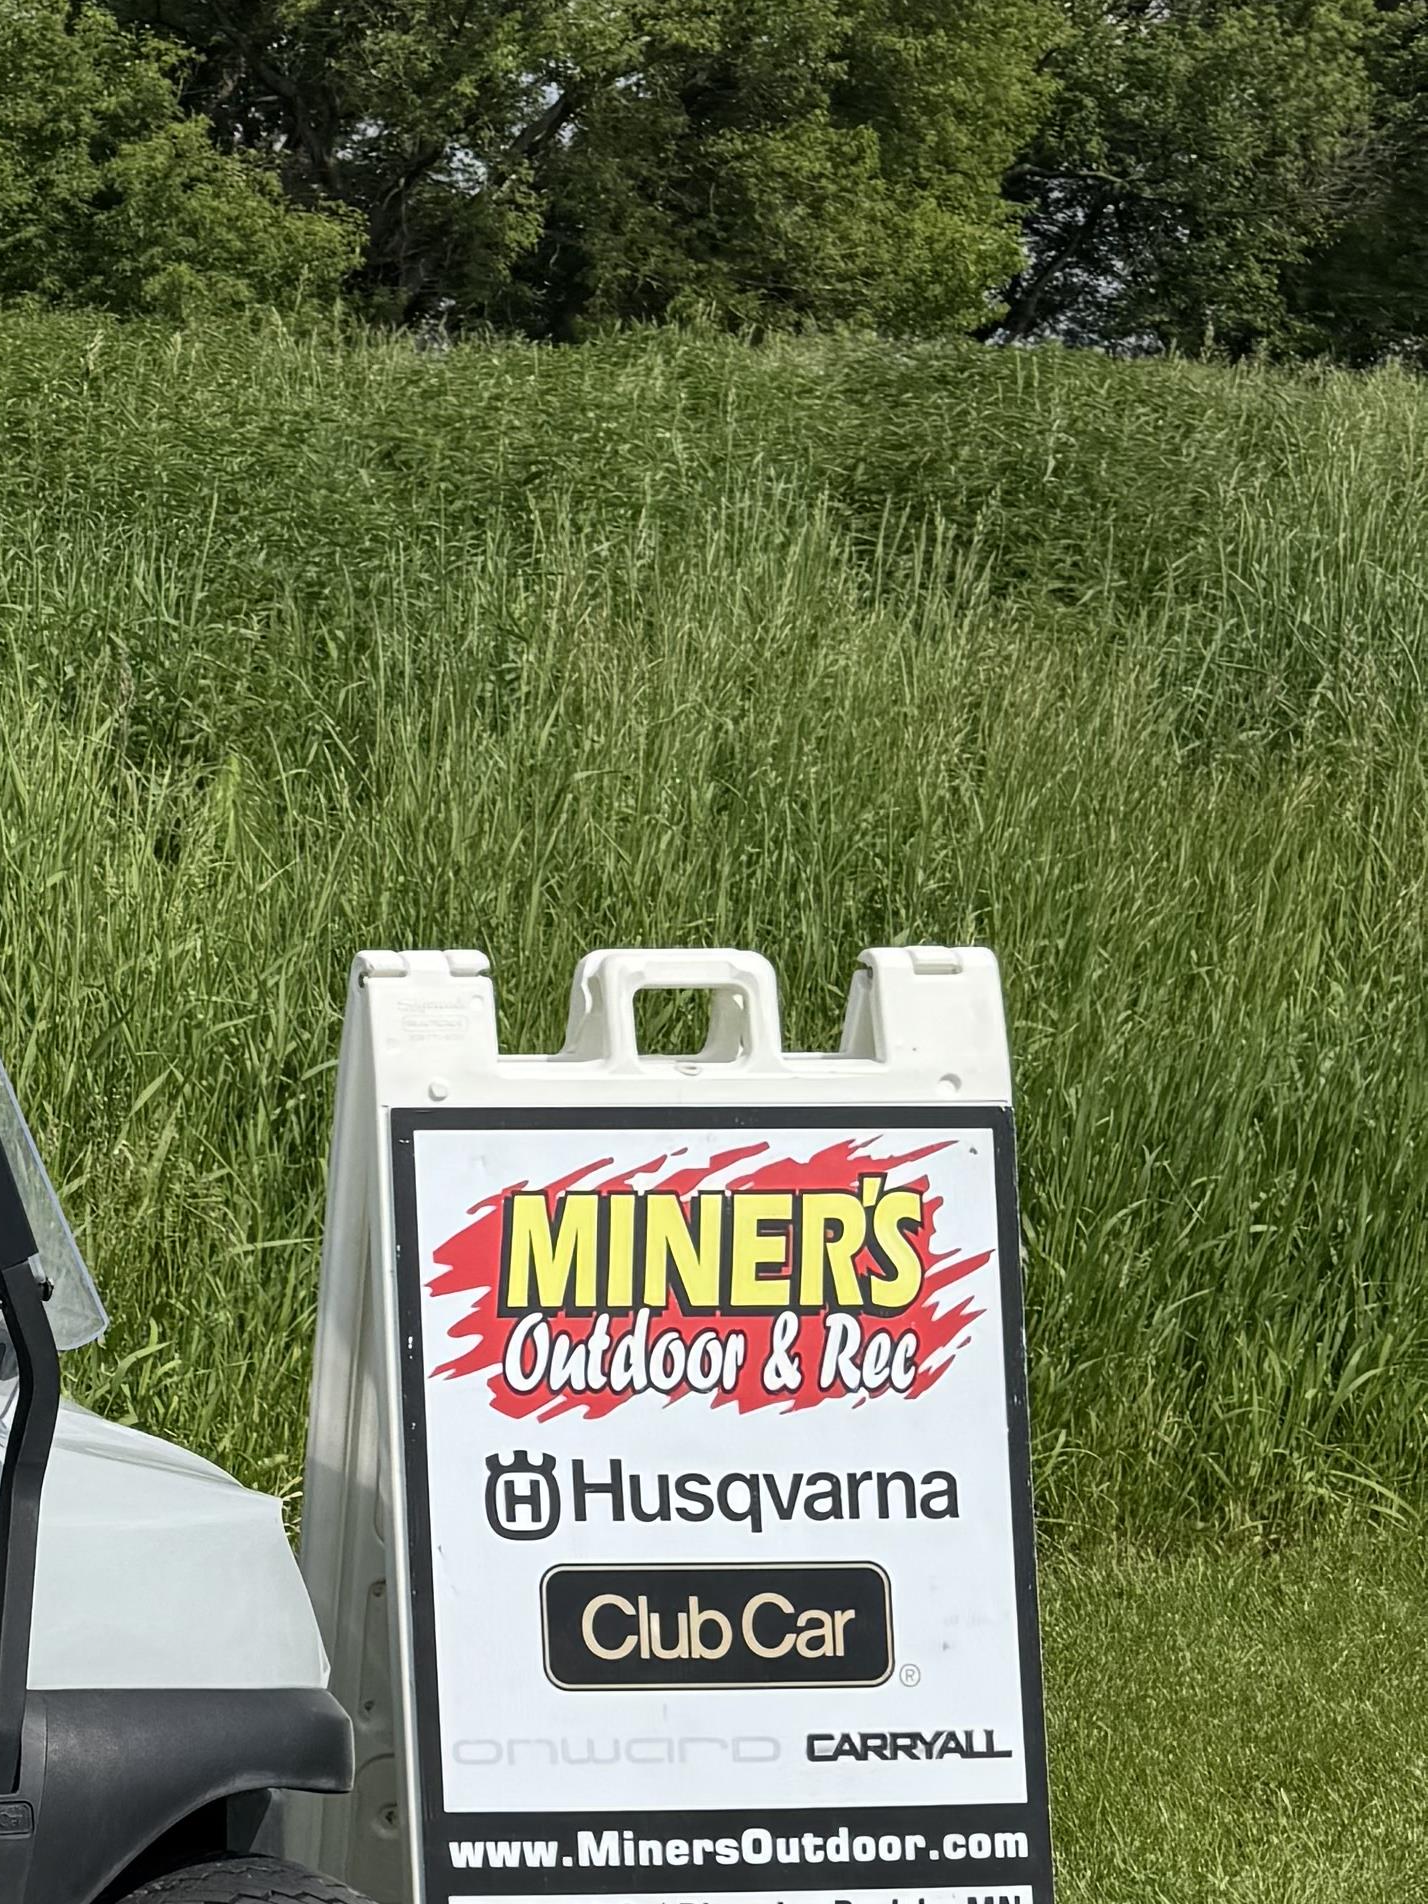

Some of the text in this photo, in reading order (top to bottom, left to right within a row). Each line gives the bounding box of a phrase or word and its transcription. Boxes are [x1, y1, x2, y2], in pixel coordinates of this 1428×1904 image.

[500, 1173, 924, 1313] MINER'S
[504, 1307, 919, 1393] Outdoor & Rec
[571, 1458, 959, 1533] Husqvarna
[581, 1592, 855, 1660] Club Car
[806, 1728, 1013, 1762] CARRYALL
[448, 1827, 1029, 1868] www.MinersOutdoor.com
